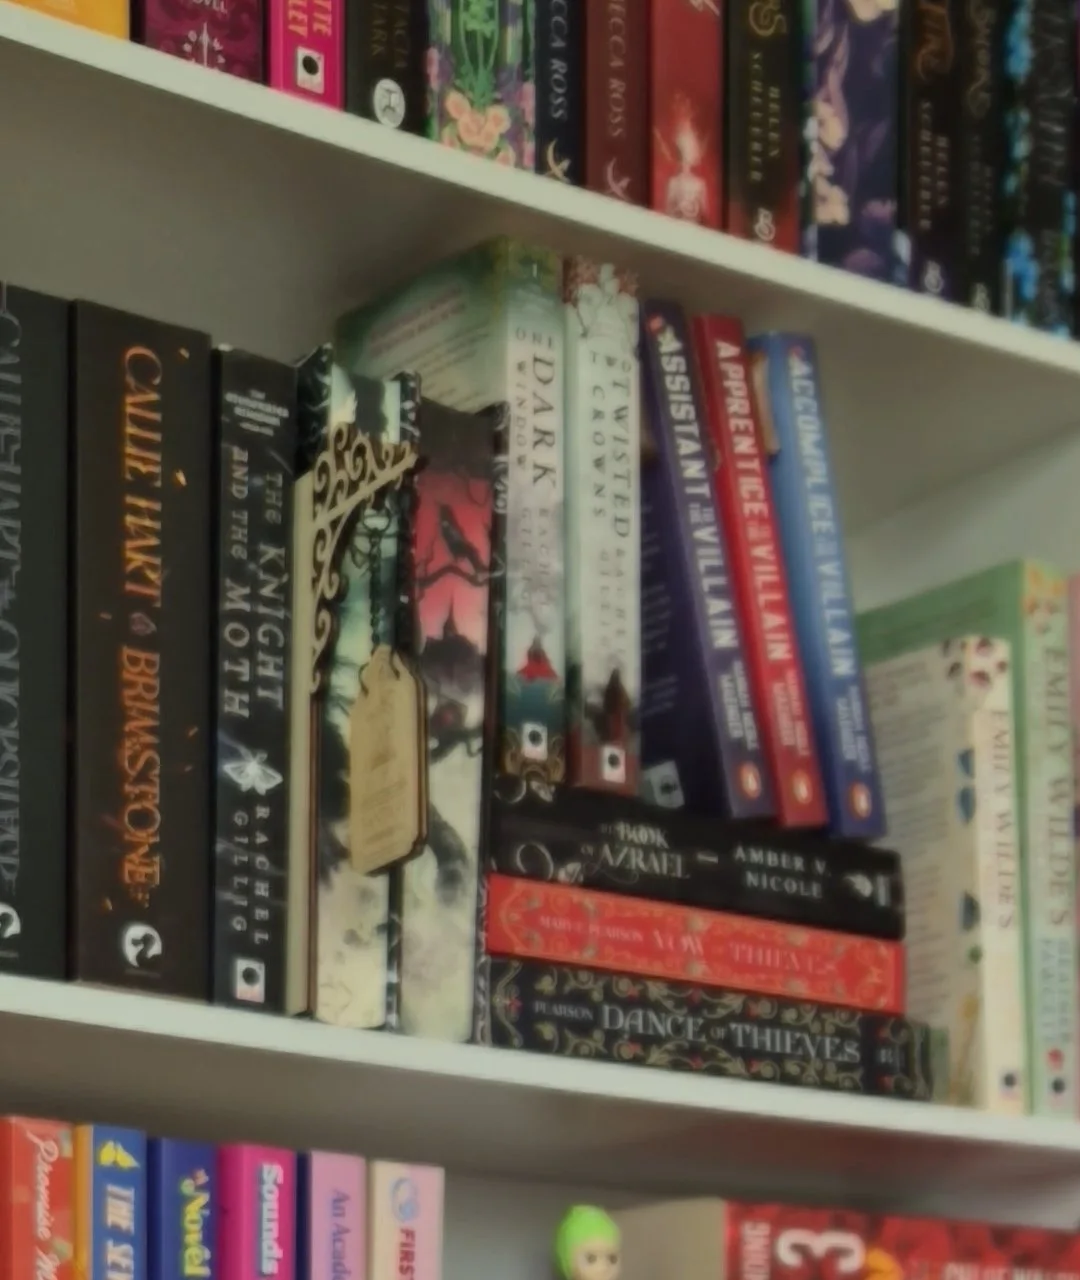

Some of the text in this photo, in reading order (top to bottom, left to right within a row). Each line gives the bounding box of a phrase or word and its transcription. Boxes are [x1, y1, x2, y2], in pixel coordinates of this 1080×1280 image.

[550, 58, 568, 120] ROSS
[609, 79, 627, 137] ROSS
[516, 360, 528, 471] WINDOW
[532, 352, 557, 489] DARK
[592, 384, 606, 517] CROWNS
[612, 376, 633, 539] TWISTED
[660, 338, 713, 499] ASSISTANT
[692, 525, 741, 649] VILLAIN
[717, 340, 793, 660] APPRENTICE VILLAIN
[789, 360, 837, 534] ACCOMPLICE
[816, 563, 857, 676] VILLAIN
[122, 345, 163, 889] CALLIE HART BRIMSTONE
[224, 447, 251, 719] AND THE MOTH
[257, 472, 287, 711] THE KNIGHT
[990, 711, 1012, 795] EMILY
[1045, 645, 1071, 756] EMILY
[232, 810, 249, 933] GILLIG
[255, 804, 271, 945] RACHEL
[598, 843, 691, 880] AZRAEL
[614, 820, 669, 850] BOOK
[733, 844, 805, 873] AMBER
[744, 869, 823, 900] NICOLE
[728, 941, 840, 976] THIEVES
[533, 1000, 863, 1063] PEARSON DANCE THIEVES
[27, 1127, 60, 1240] Promise
[105, 1184, 137, 1236] THE
[183, 1190, 212, 1279] Novel
[260, 1163, 285, 1276] Sounds
[331, 1188, 352, 1218] An
